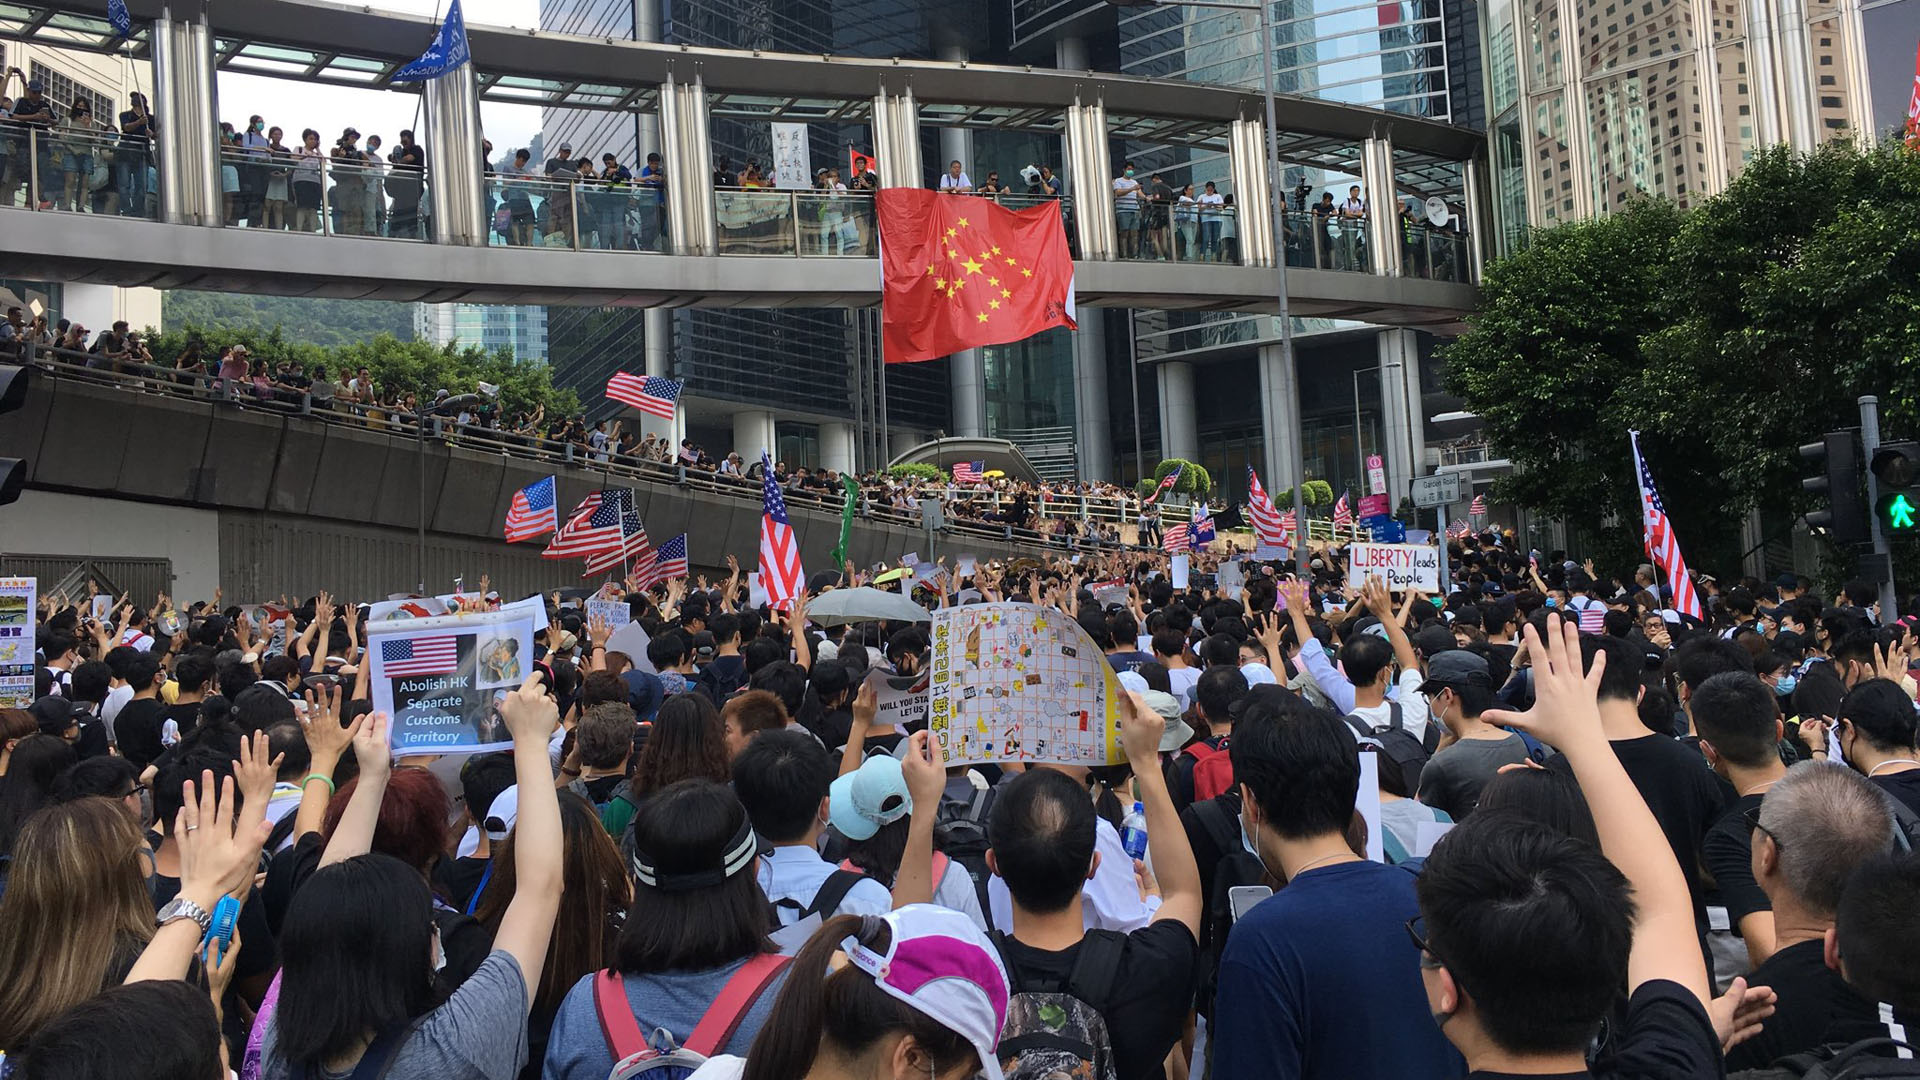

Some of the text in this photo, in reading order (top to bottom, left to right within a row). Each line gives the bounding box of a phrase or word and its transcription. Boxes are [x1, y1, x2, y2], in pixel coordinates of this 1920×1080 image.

[1423, 481, 1441, 489] Garden
[1354, 547, 1436, 568] LIBERTY leads
[1388, 568, 1423, 587] People
[399, 676, 468, 693] Abolish HK
[407, 696, 462, 711] Separate
[880, 701, 898, 711] WILL
[900, 698, 913, 707] YOU
[406, 714, 460, 726] Customs
[901, 708, 912, 717] LET
[404, 730, 460, 745] Territory
